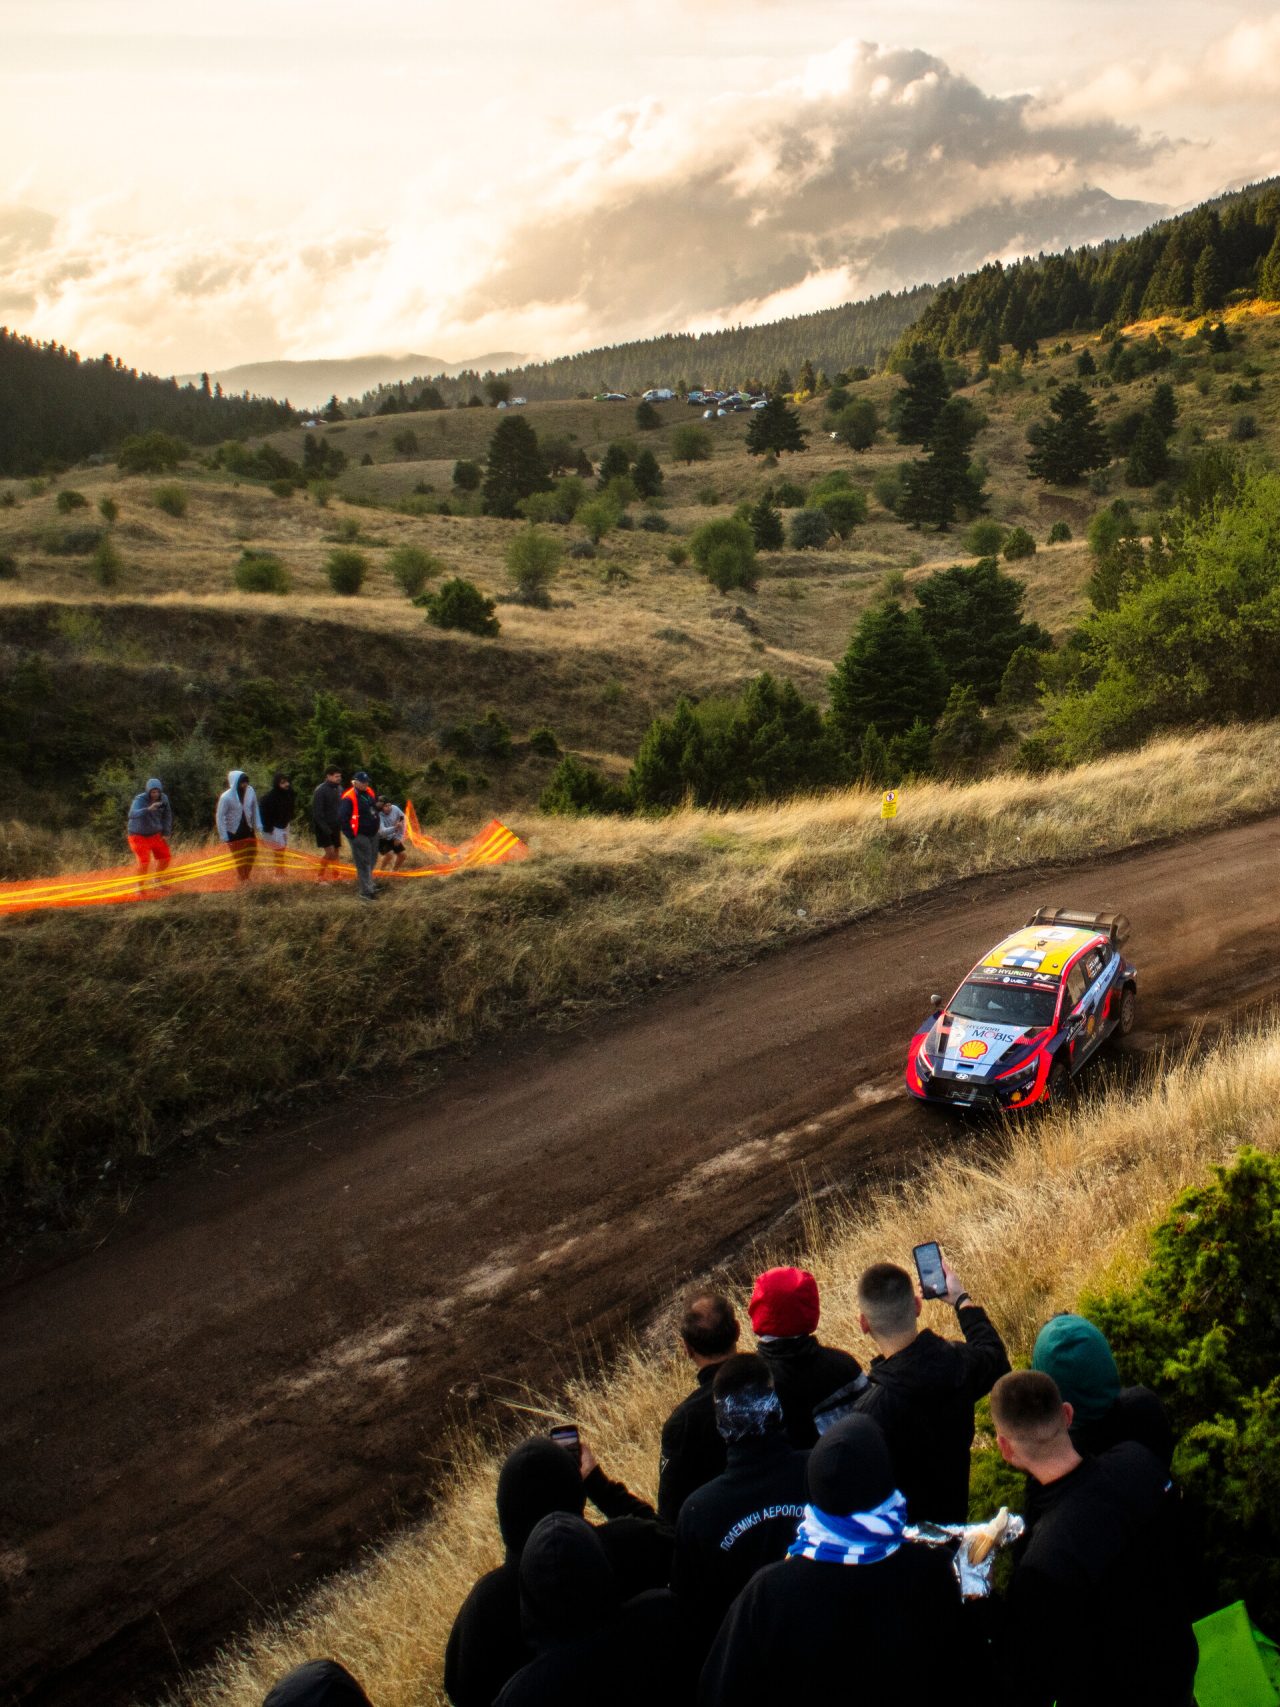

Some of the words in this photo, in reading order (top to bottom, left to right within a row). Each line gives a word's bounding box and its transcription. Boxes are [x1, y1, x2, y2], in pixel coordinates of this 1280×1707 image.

[998, 969, 1033, 978] HYUNDAI
[967, 1024, 1000, 1032] HYUNDAI
[971, 1030, 1015, 1043] MOBIS
[720, 1511, 762, 1552] ΠΟΛΕΜΙΚΗ
